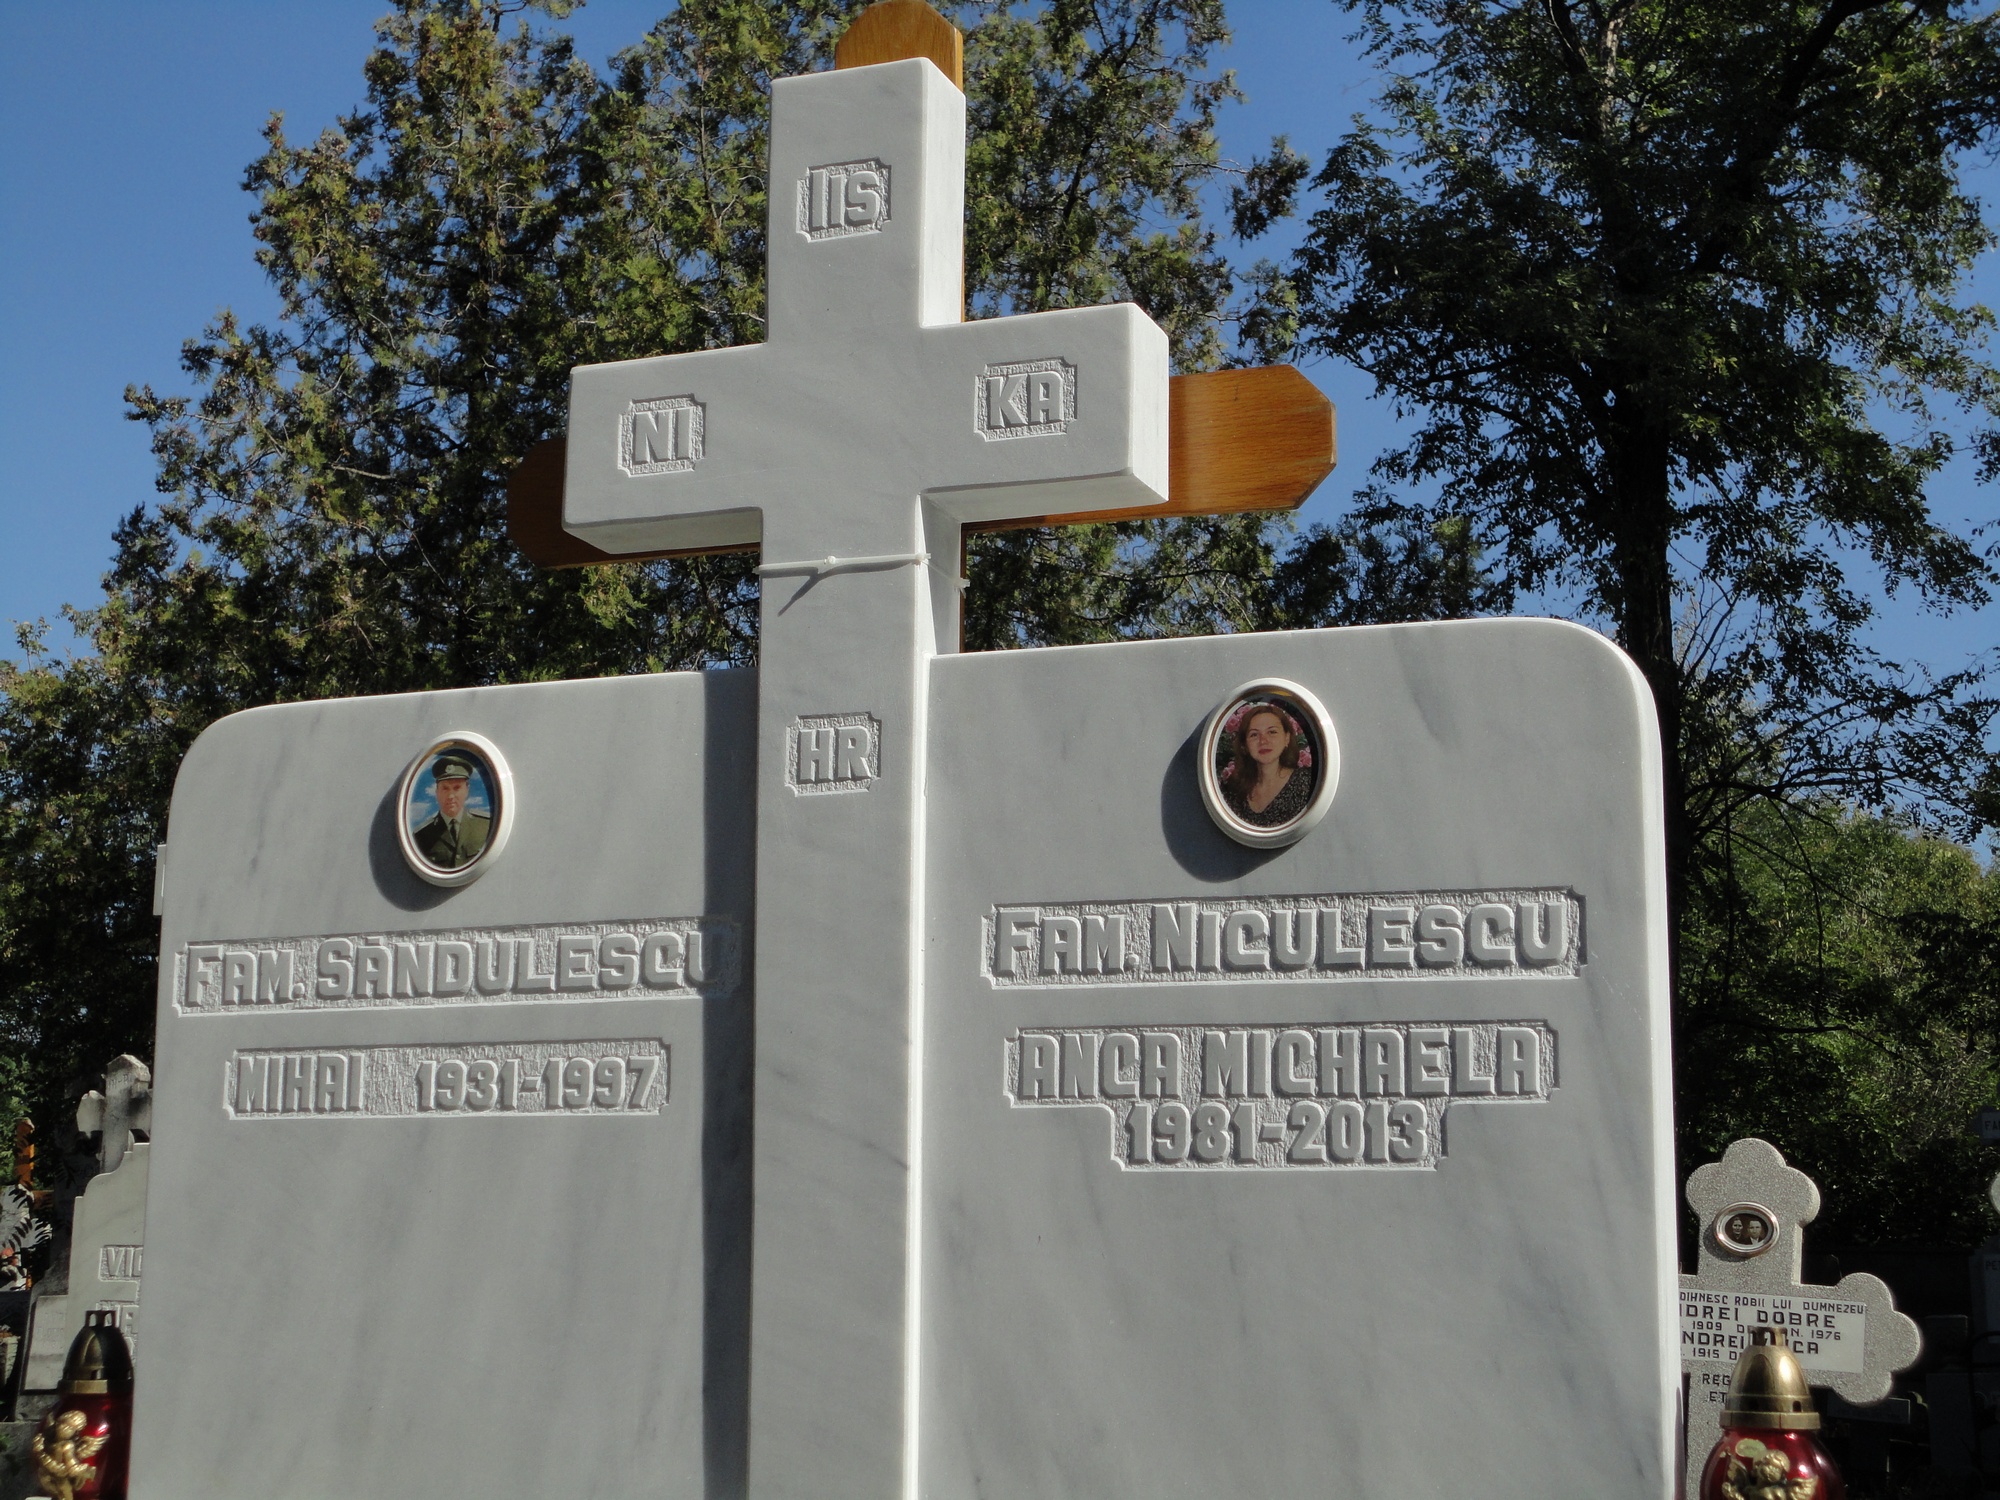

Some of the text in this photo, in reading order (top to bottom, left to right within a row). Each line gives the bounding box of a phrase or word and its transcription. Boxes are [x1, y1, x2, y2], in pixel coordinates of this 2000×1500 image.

[810, 167, 883, 232] IIS
[986, 371, 1067, 430] KA
[633, 406, 693, 465] NI
[796, 725, 872, 785] HR
[997, 900, 1569, 978] FAM. NICULESCU
[186, 939, 306, 1008] FAM.
[237, 1051, 661, 1115] MIHAI 1931-1997
[1017, 1024, 1541, 1100] ANCA MICHAELA
[1127, 1101, 1429, 1165] 1981-2013
[1680, 1291, 1729, 1305] DIHNESC
[1772, 1298, 1792, 1310] LUI
[1803, 1301, 1864, 1315] DUMNEZEU
[1692, 1320, 1723, 1331] 1909
[1811, 1329, 1842, 1341] 1976
[1756, 1309, 1836, 1329] DOBRE
[1682, 1330, 1744, 1350] NDREI
[1692, 1347, 1720, 1359] 1915
